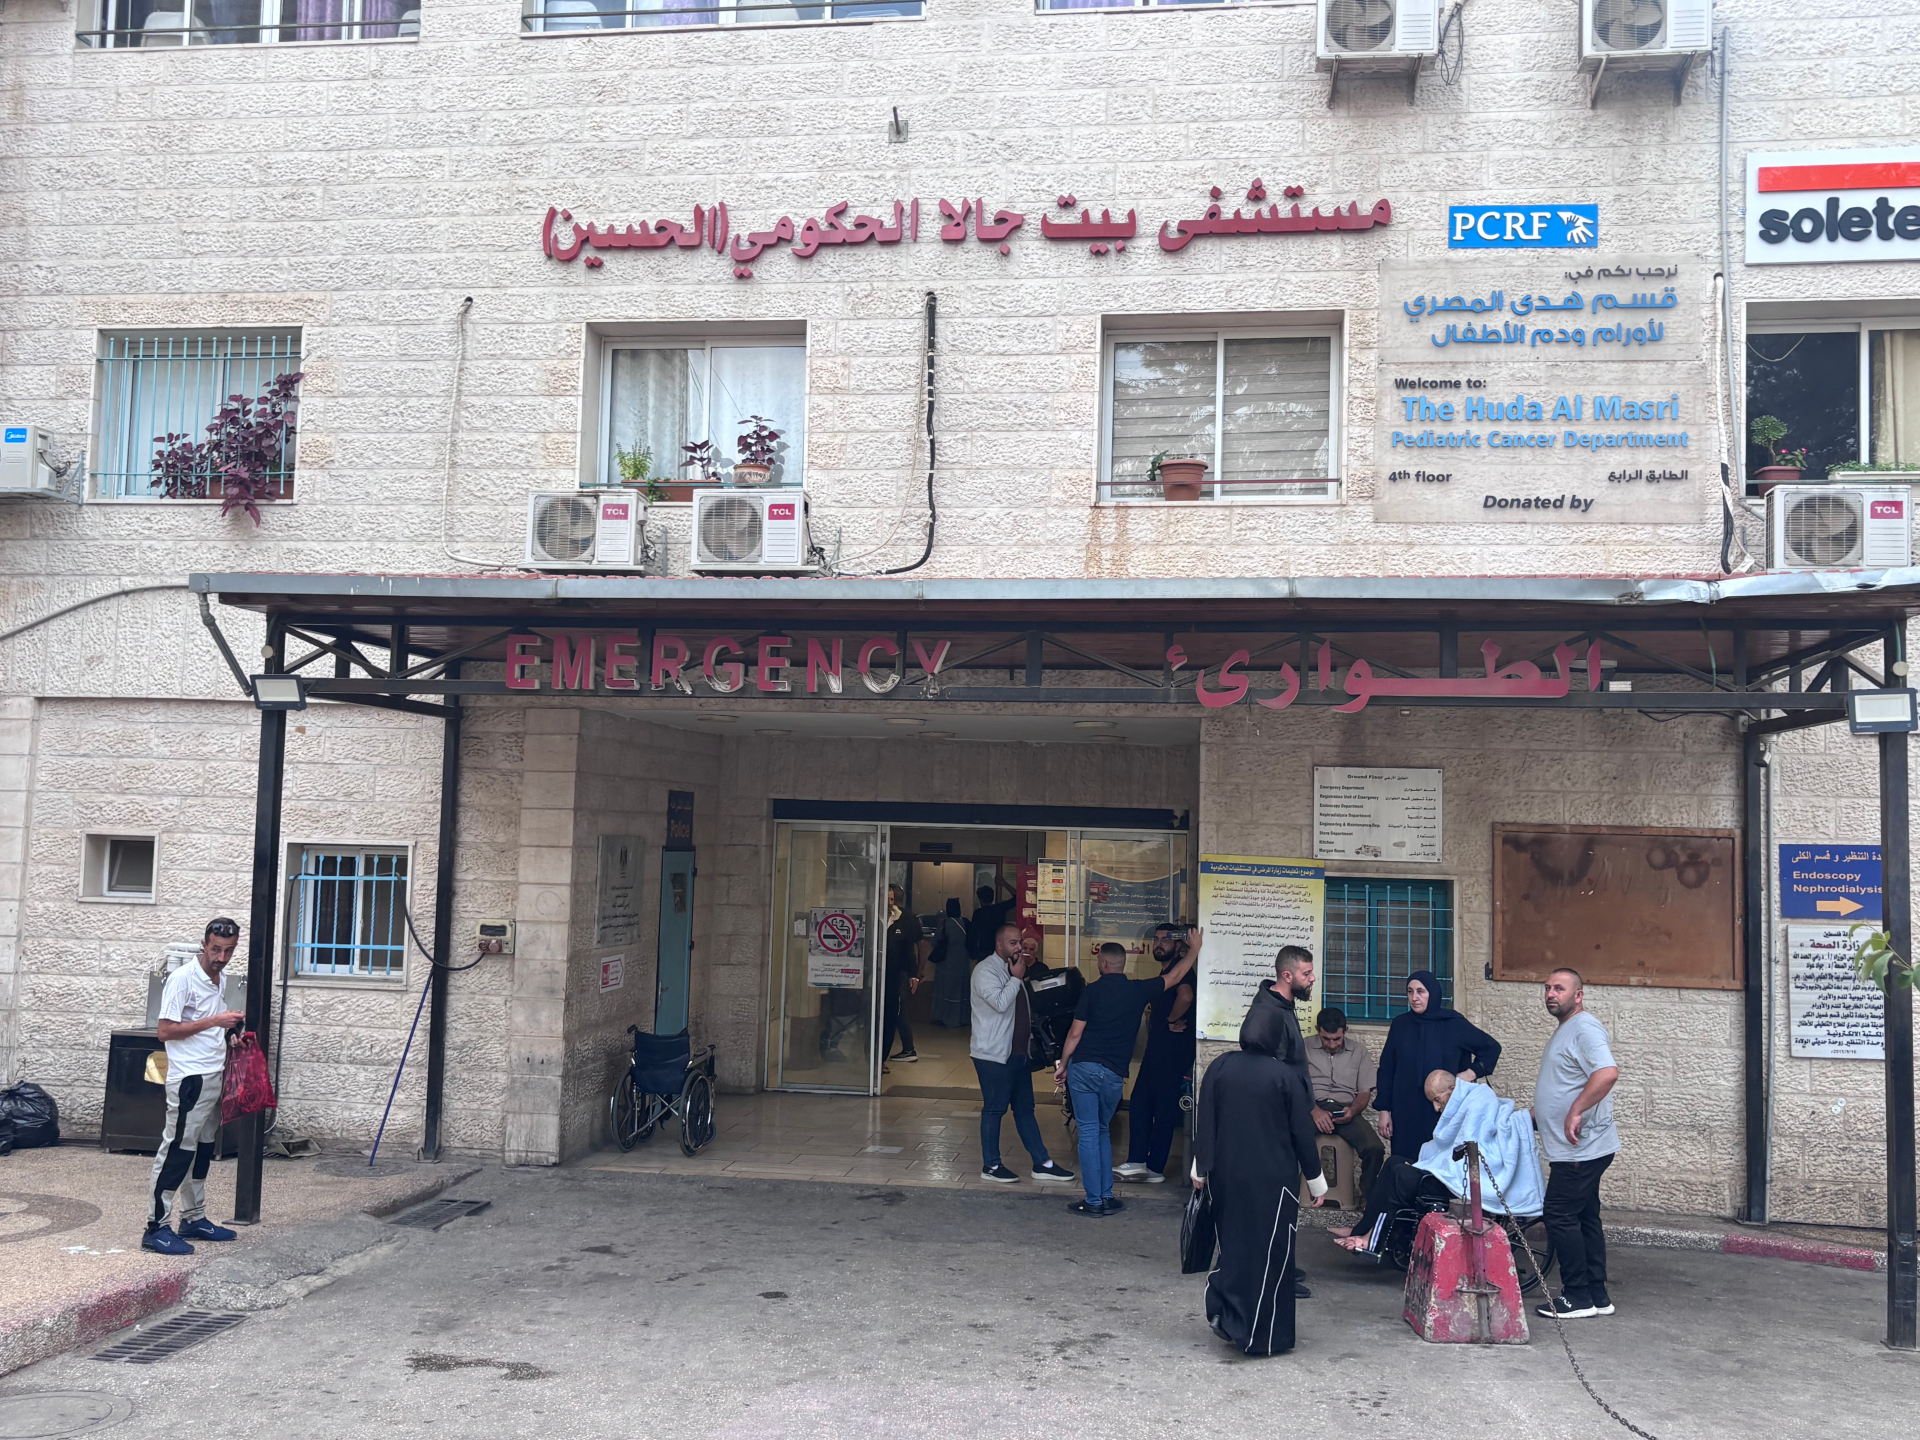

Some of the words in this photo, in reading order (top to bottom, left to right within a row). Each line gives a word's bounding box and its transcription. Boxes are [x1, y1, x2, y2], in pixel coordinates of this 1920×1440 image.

[1041, 194, 1137, 255] بيت
[1158, 177, 1392, 252] مستشفى
[939, 196, 1024, 256] جالا
[1452, 211, 1551, 241] PCRF
[730, 197, 918, 279] الحكومي
[1636, 264, 1679, 281] نرحب
[1403, 289, 1504, 323] المصري
[1510, 290, 1584, 316] هدى
[1592, 286, 1679, 315] قسم
[1431, 320, 1526, 348] الأطفال
[1531, 327, 1586, 348] ودم
[1592, 317, 1664, 347] لأورام
[1394, 378, 1461, 390] Welcome
[1465, 377, 1488, 390] to:
[1402, 396, 1455, 421] The
[1465, 394, 1543, 421] Huda
[1552, 394, 1583, 420] Al
[1594, 393, 1680, 420] Masri
[1391, 430, 1481, 448] Pediatric
[1487, 430, 1557, 448] Cancer
[1563, 430, 1689, 452] Department
[1388, 470, 1411, 483] 4th
[1414, 471, 1453, 483] floor
[1607, 469, 1642, 481] الرابع
[1645, 469, 1689, 484] الطابق
[605, 508, 625, 516] TCL
[771, 508, 792, 516] TCL
[1482, 495, 1566, 510] Donated
[1569, 495, 1594, 513] by
[1874, 506, 1899, 514] TCL
[505, 634, 952, 698] EMERGENCY
[1165, 637, 1600, 713] الطوارئ
[1814, 850, 1831, 864] قسم
[1842, 850, 1869, 863] التنظير
[1793, 871, 1861, 881] Endoscopy
[1843, 940, 1860, 951] زارة
